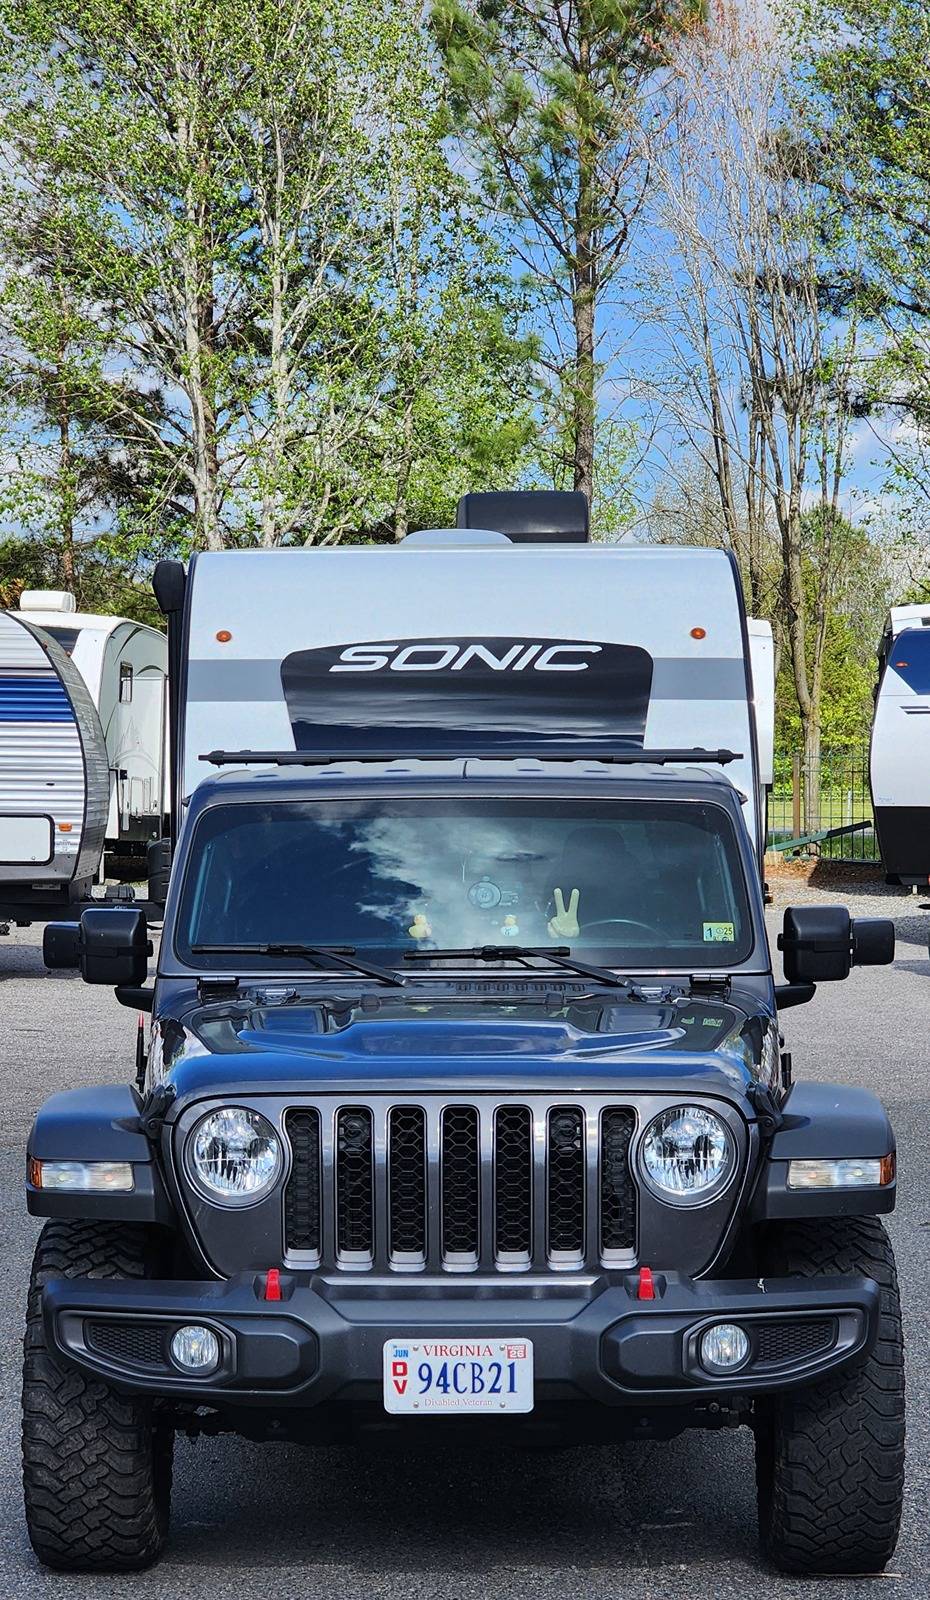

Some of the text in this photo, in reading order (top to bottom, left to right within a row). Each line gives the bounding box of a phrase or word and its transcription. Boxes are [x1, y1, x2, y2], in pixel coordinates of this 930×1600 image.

[329, 644, 603, 672] SONIC
[393, 1349, 409, 1358] JUN
[423, 1344, 493, 1357] VIRGINIA
[510, 1350, 525, 1359] 26
[418, 1362, 518, 1395] 94CB21
[424, 1399, 493, 1407] Disabled Veteran
